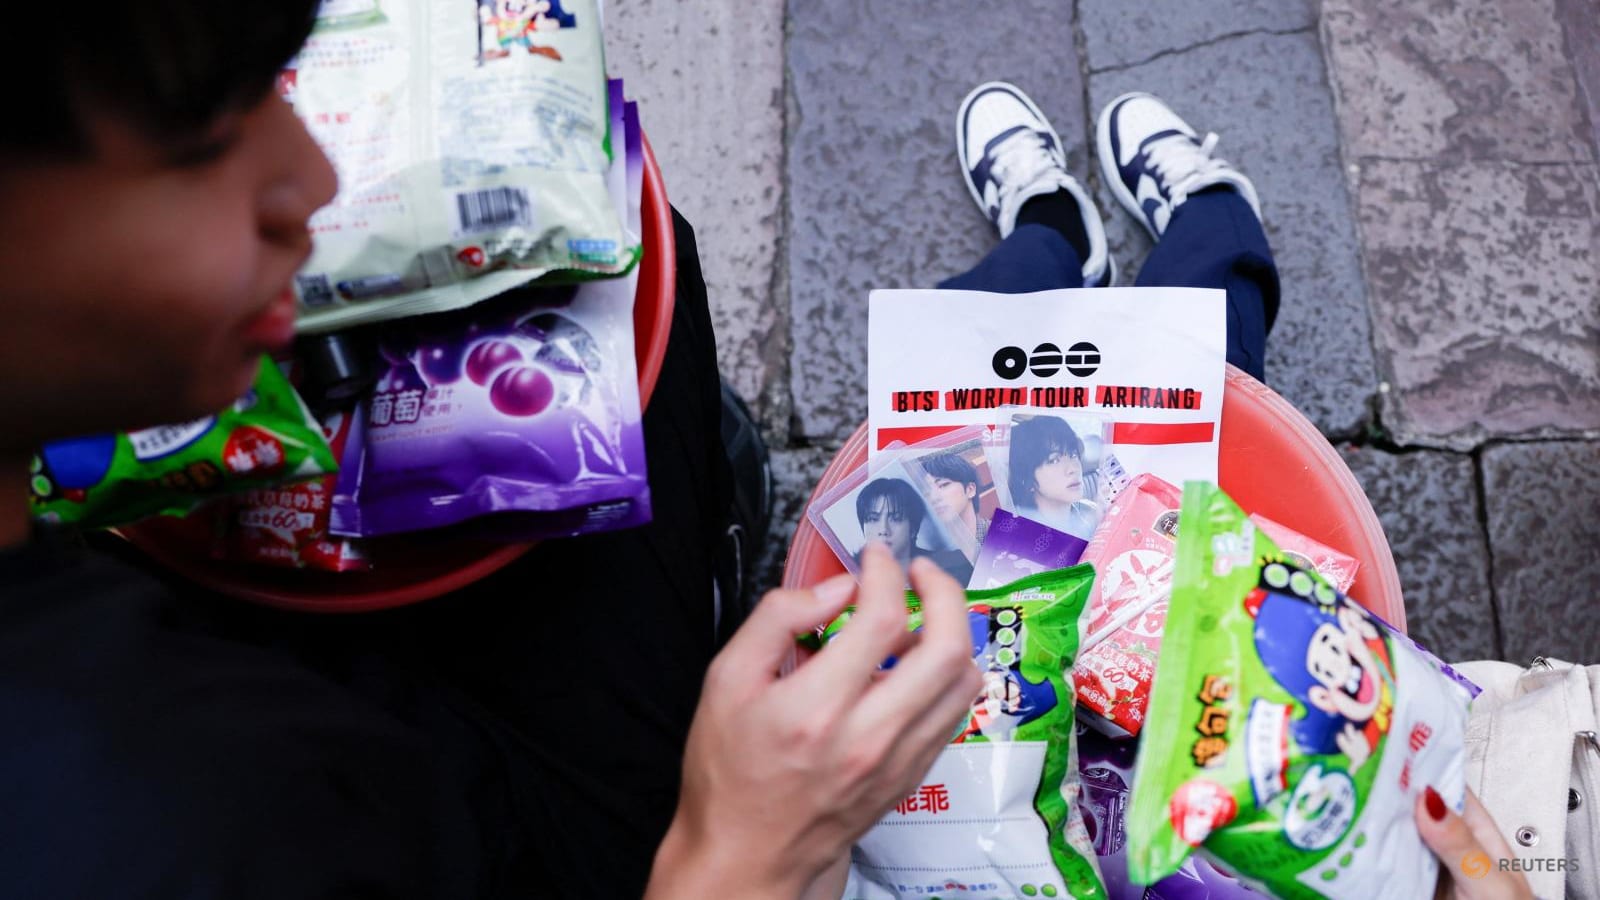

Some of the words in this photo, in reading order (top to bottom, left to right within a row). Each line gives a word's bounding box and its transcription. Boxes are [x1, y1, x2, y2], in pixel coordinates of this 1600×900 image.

[897, 390, 934, 412] BTS
[1033, 386, 1085, 408] TOUR
[1102, 386, 1195, 410] ARIRANG
